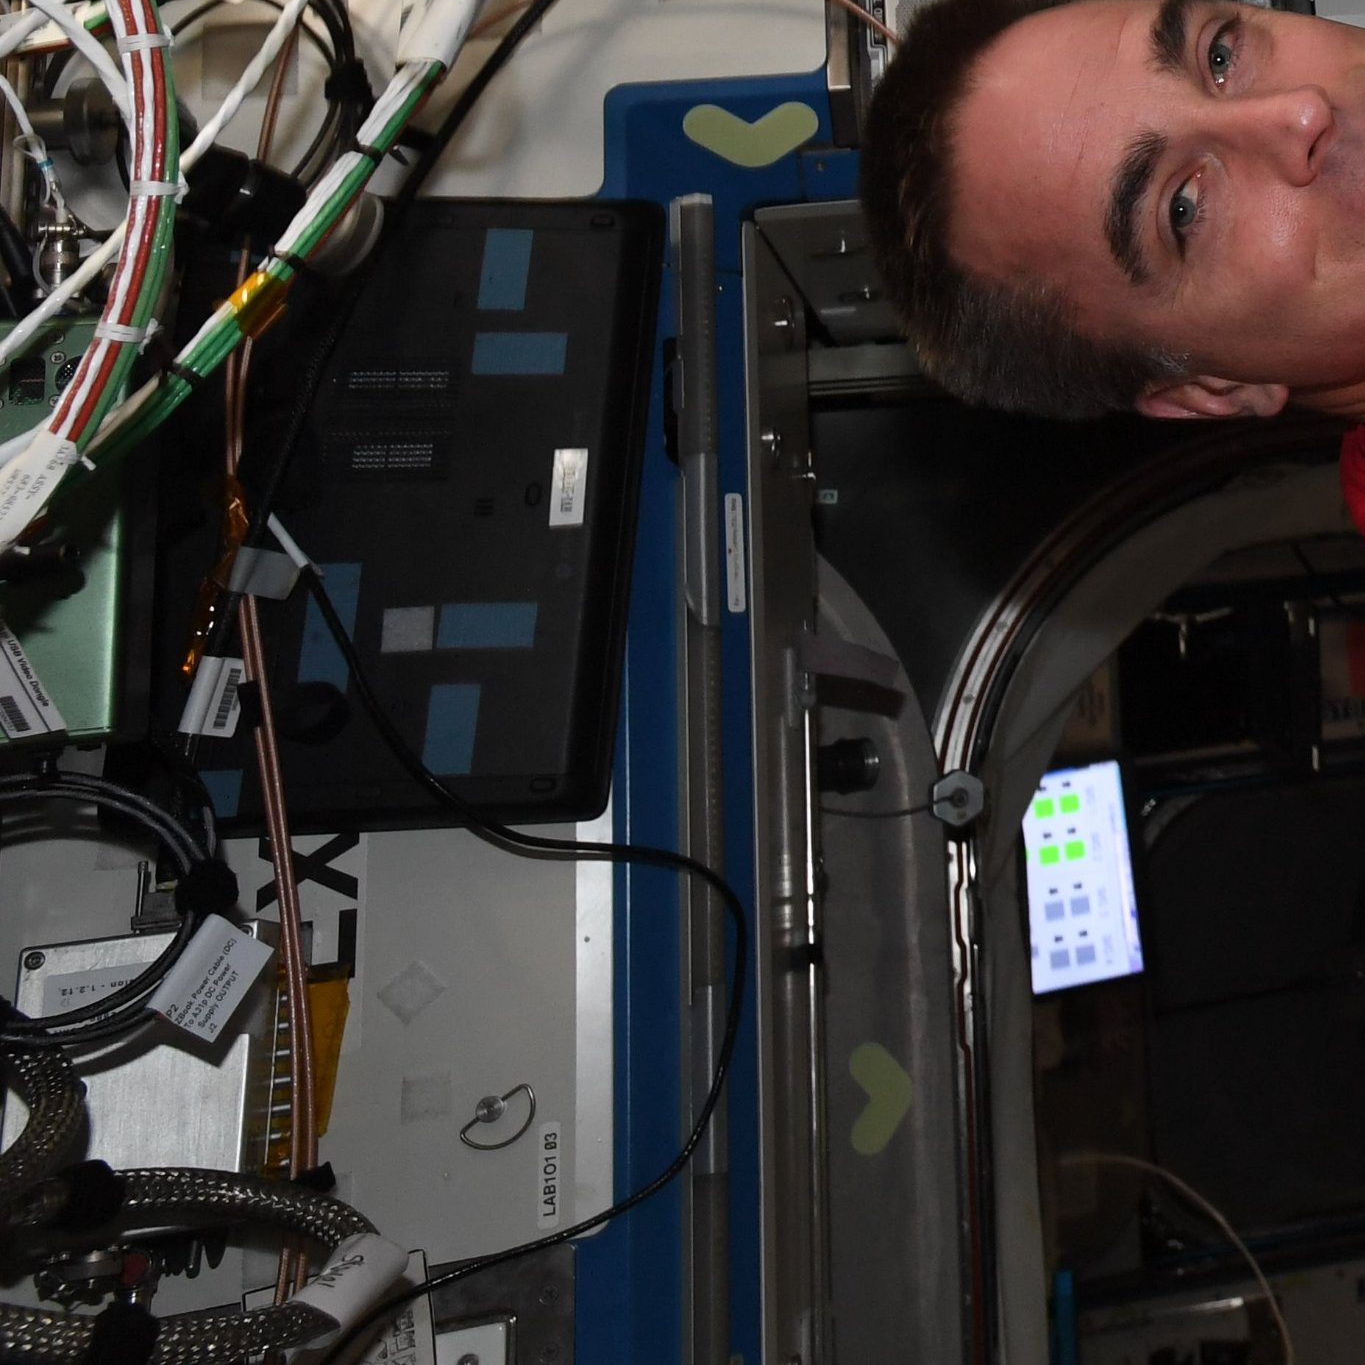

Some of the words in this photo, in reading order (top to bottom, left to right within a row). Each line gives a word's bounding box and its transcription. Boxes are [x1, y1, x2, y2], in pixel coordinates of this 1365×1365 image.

[7, 638, 21, 657] USB
[16, 658, 35, 680] Video
[30, 681, 51, 708] Dongle
[165, 1002, 180, 1019] P2
[174, 999, 195, 1025] ZBook
[190, 974, 211, 1001] Power
[206, 952, 226, 977] Cable
[220, 936, 238, 956] (DC)
[184, 1017, 195, 1028] To
[190, 997, 210, 1020] A31p
[203, 984, 217, 999] DC
[211, 961, 232, 987] Power
[196, 1000, 220, 1029] Supply
[214, 969, 240, 1003] OUTPUT
[206, 1021, 218, 1033] J2
